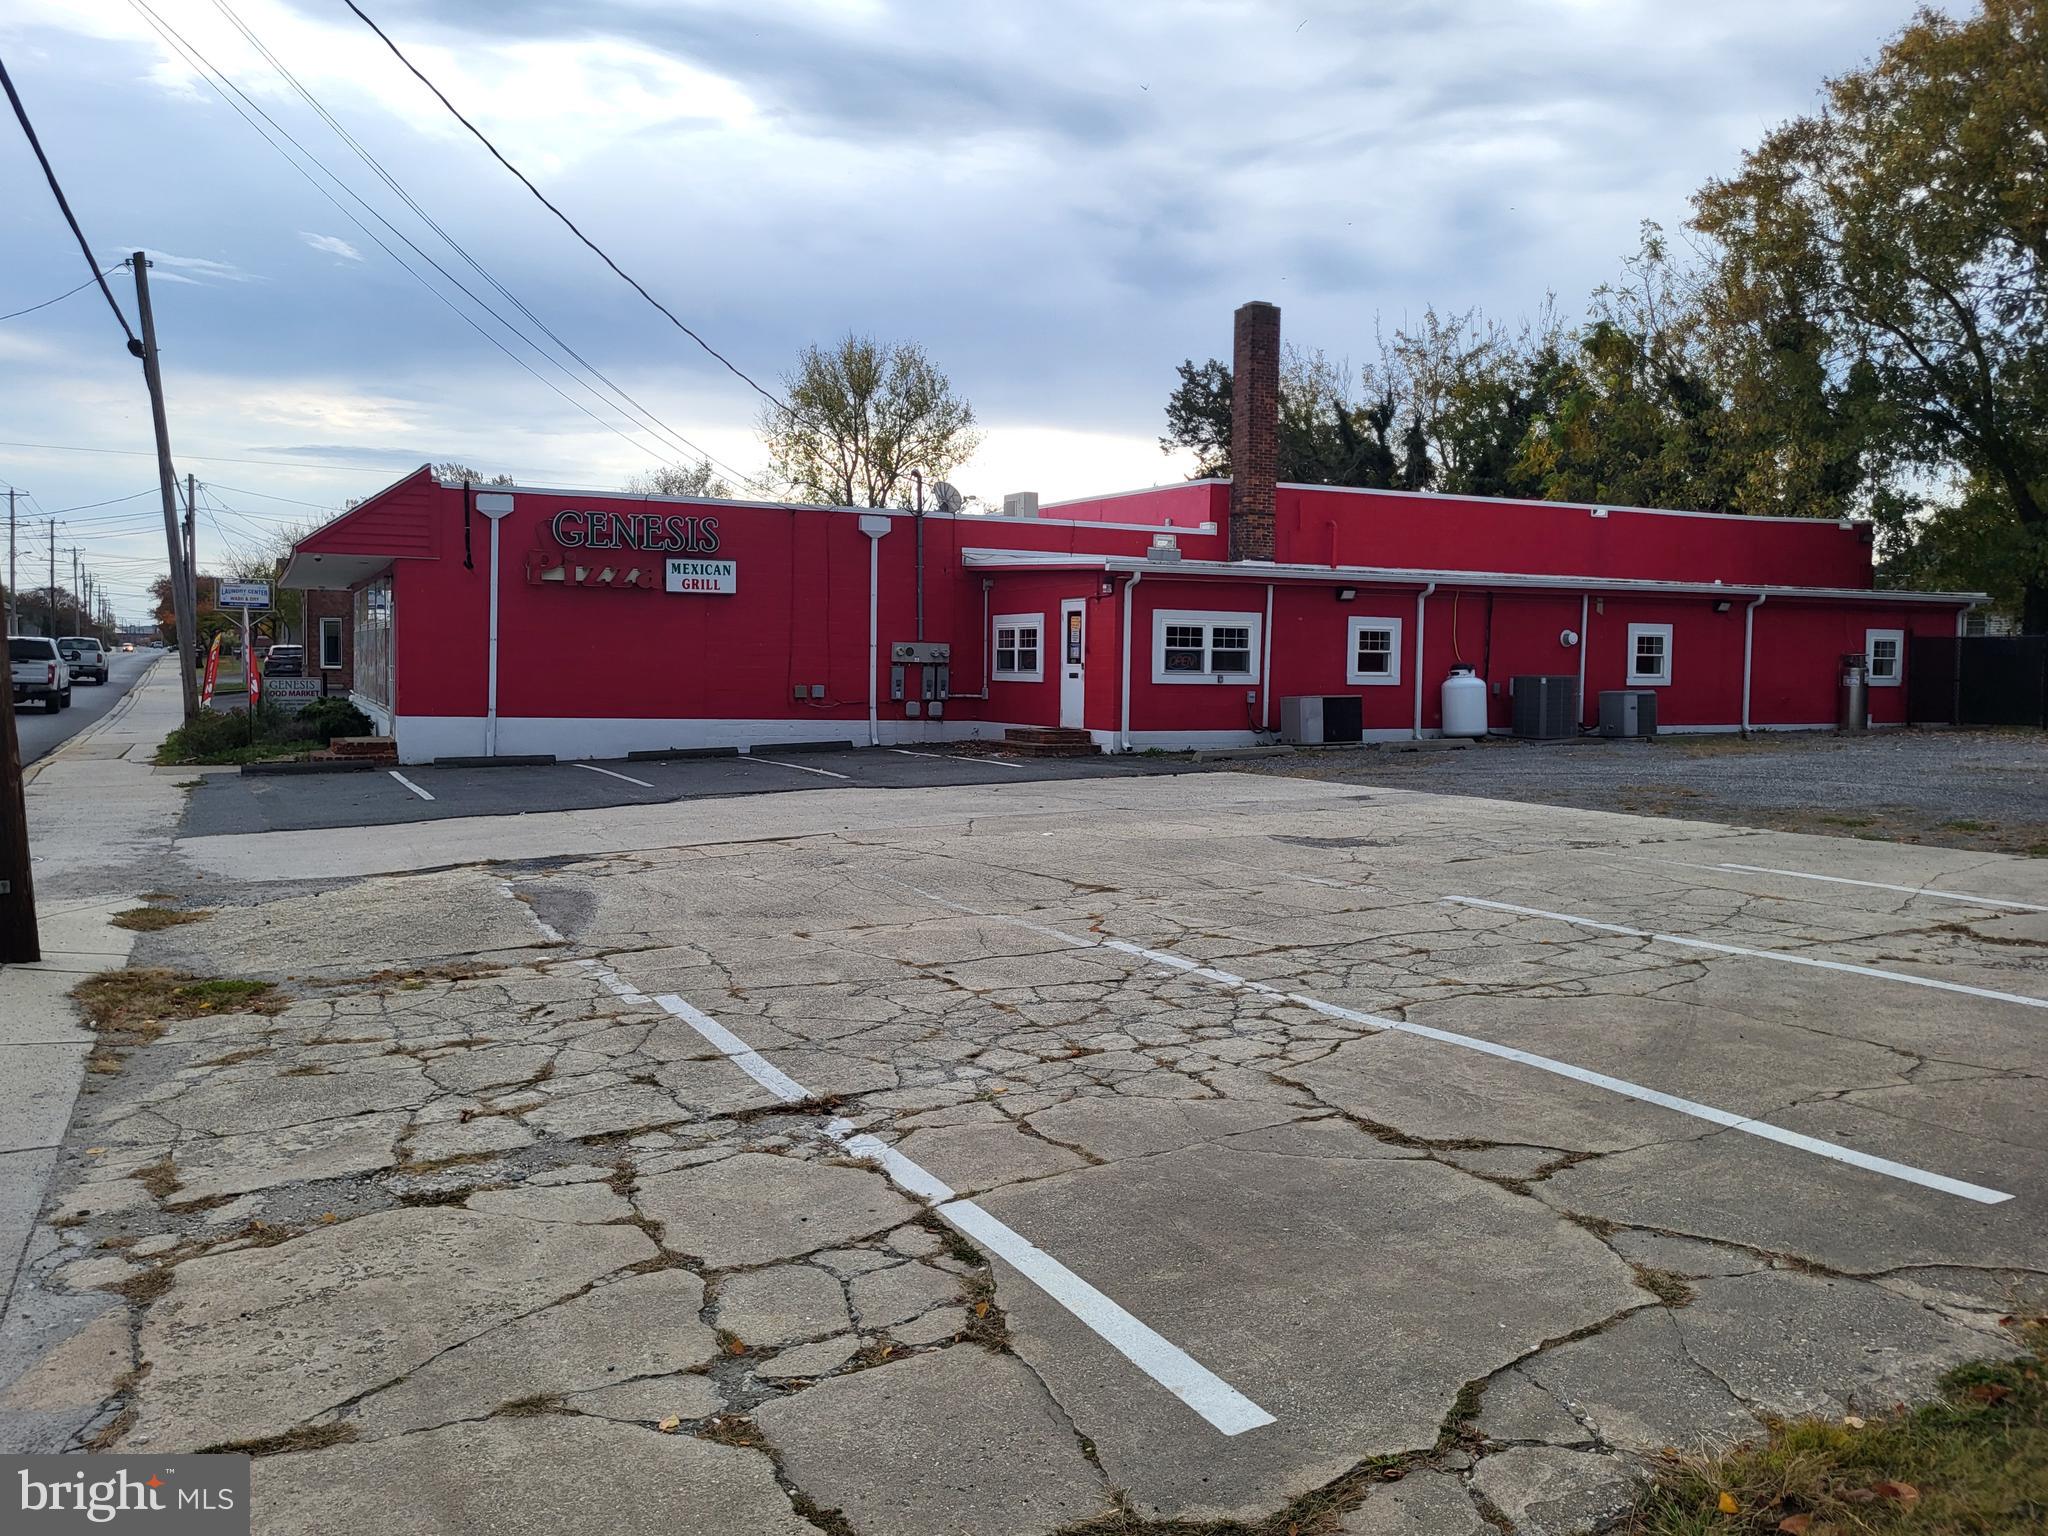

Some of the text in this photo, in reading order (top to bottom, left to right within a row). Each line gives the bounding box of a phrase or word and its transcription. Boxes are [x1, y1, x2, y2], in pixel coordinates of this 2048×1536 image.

[552, 509, 720, 553] GENESIS
[671, 561, 731, 577] MEXICAN
[682, 577, 720, 591] GRILL
[269, 679, 315, 690] GENESIS
